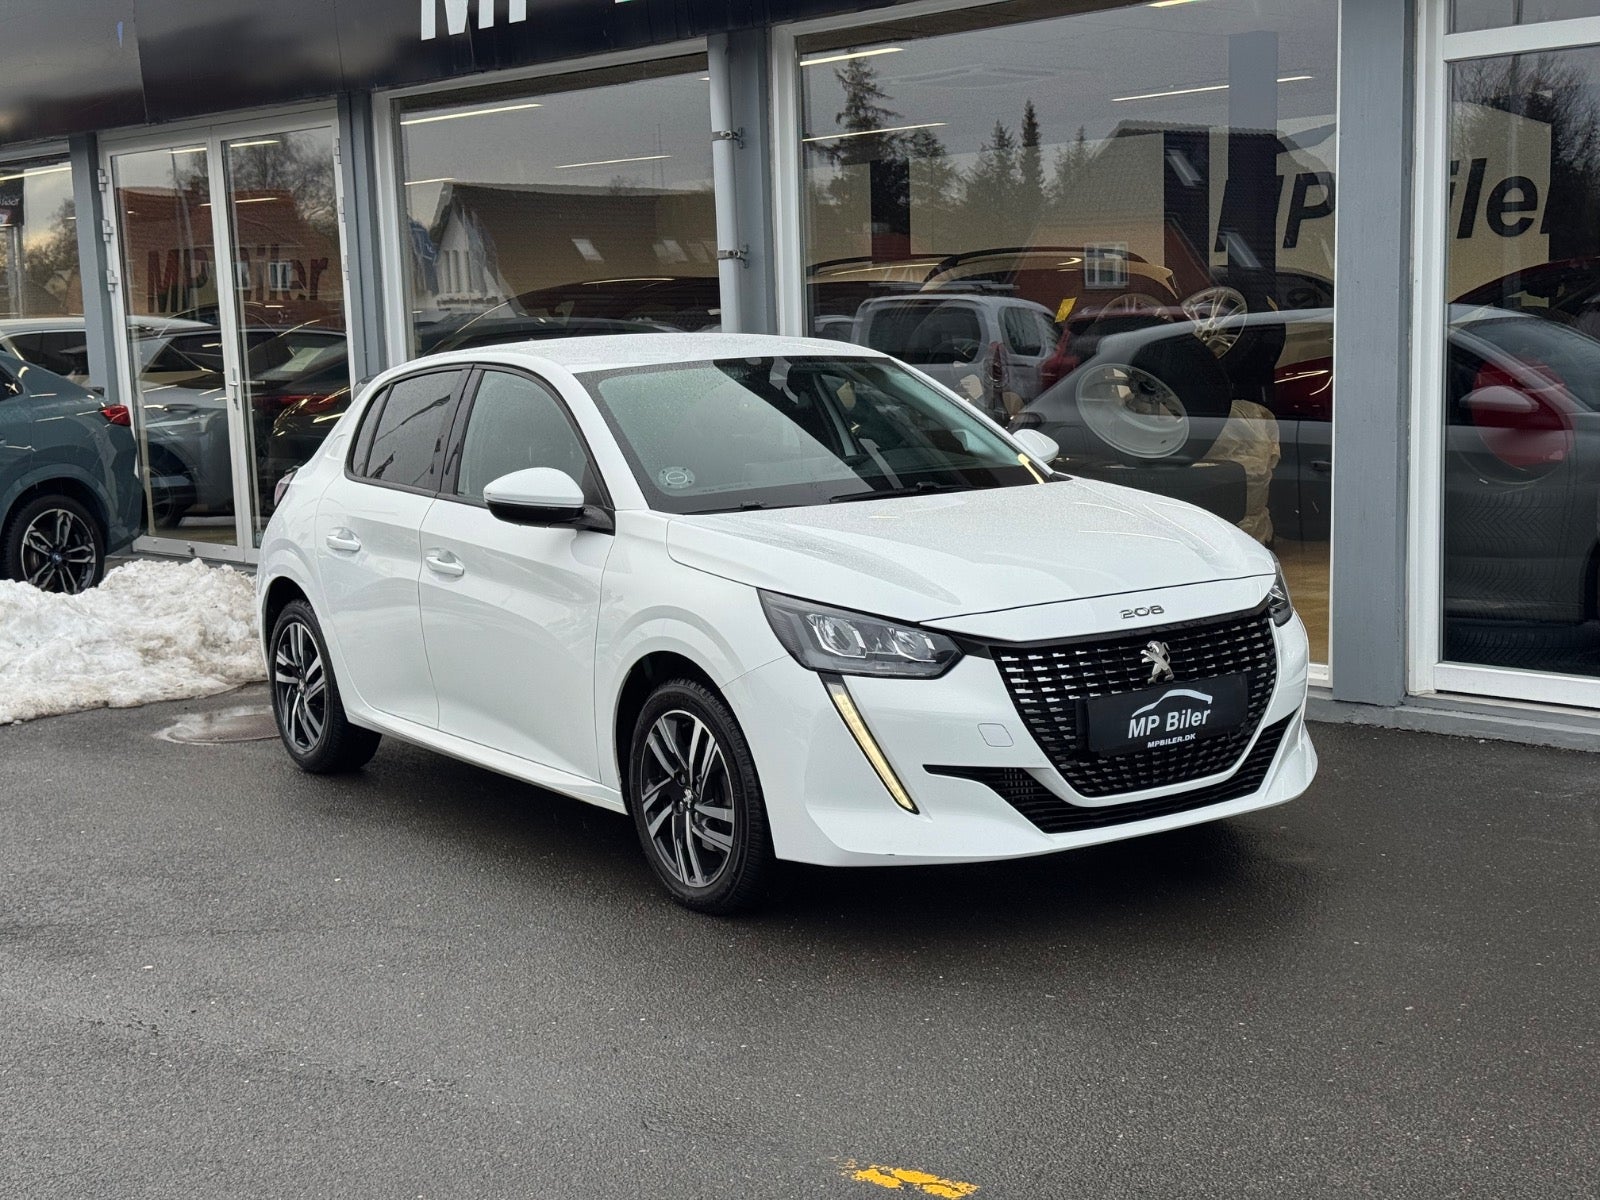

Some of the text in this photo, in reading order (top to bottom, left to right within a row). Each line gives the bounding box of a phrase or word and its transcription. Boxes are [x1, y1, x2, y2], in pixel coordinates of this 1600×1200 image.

[147, 248, 209, 313] MP
[1120, 605, 1164, 619] 208
[1127, 708, 1211, 739] MP Biler
[1147, 732, 1196, 748] MPBILER.DK
